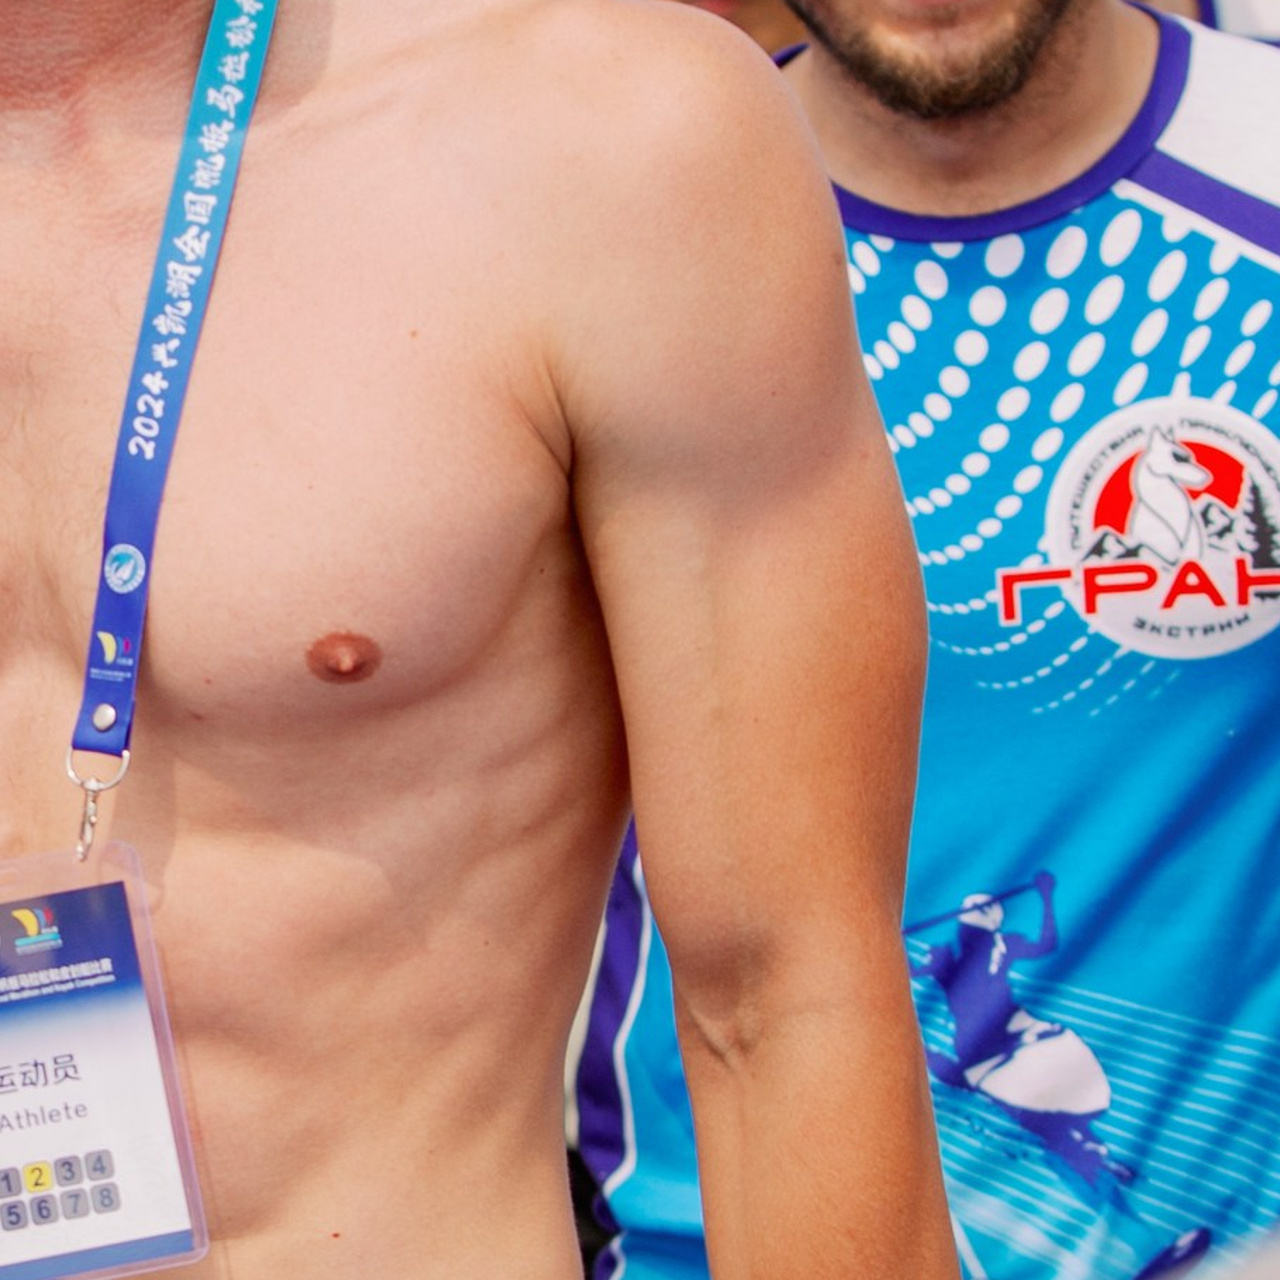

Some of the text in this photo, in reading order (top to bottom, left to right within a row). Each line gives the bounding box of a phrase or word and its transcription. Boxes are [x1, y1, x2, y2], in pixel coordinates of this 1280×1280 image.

[1, 1155, 107, 1193] 1 2 3 4
[6, 1187, 114, 1226] 5 6 7 8
